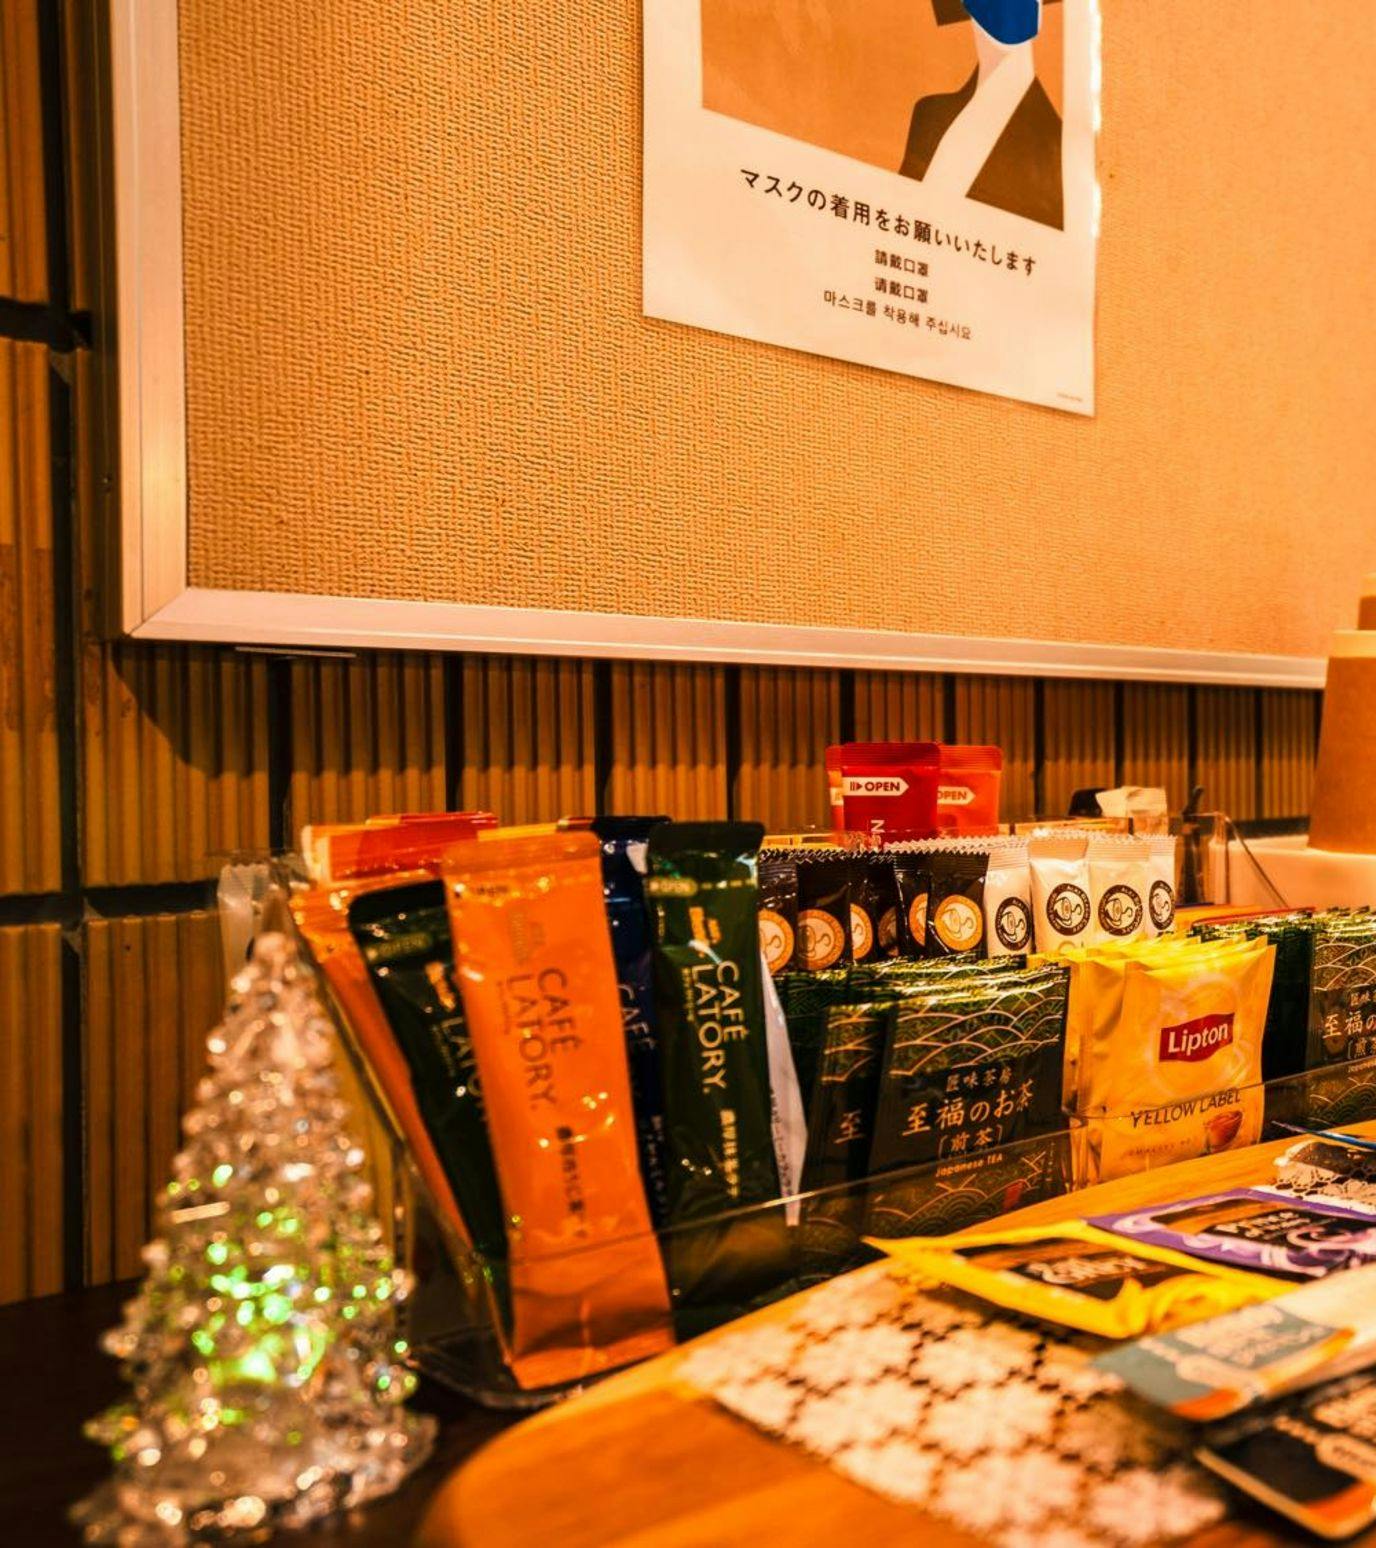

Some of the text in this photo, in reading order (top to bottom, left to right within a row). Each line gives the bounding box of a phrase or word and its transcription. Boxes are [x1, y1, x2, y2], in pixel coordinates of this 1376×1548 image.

[740, 167, 1037, 277] マスクの着用をお願いいたします
[823, 290, 876, 316] 마스크를
[883, 304, 920, 327] 착용해
[864, 780, 901, 792] OPEN
[1168, 1023, 1229, 1056] Lipton
[902, 1079, 1035, 1137] 至福のお茶
[1131, 1088, 1241, 1129] YELLOW LABEL
[935, 1159, 984, 1177] Japanese
